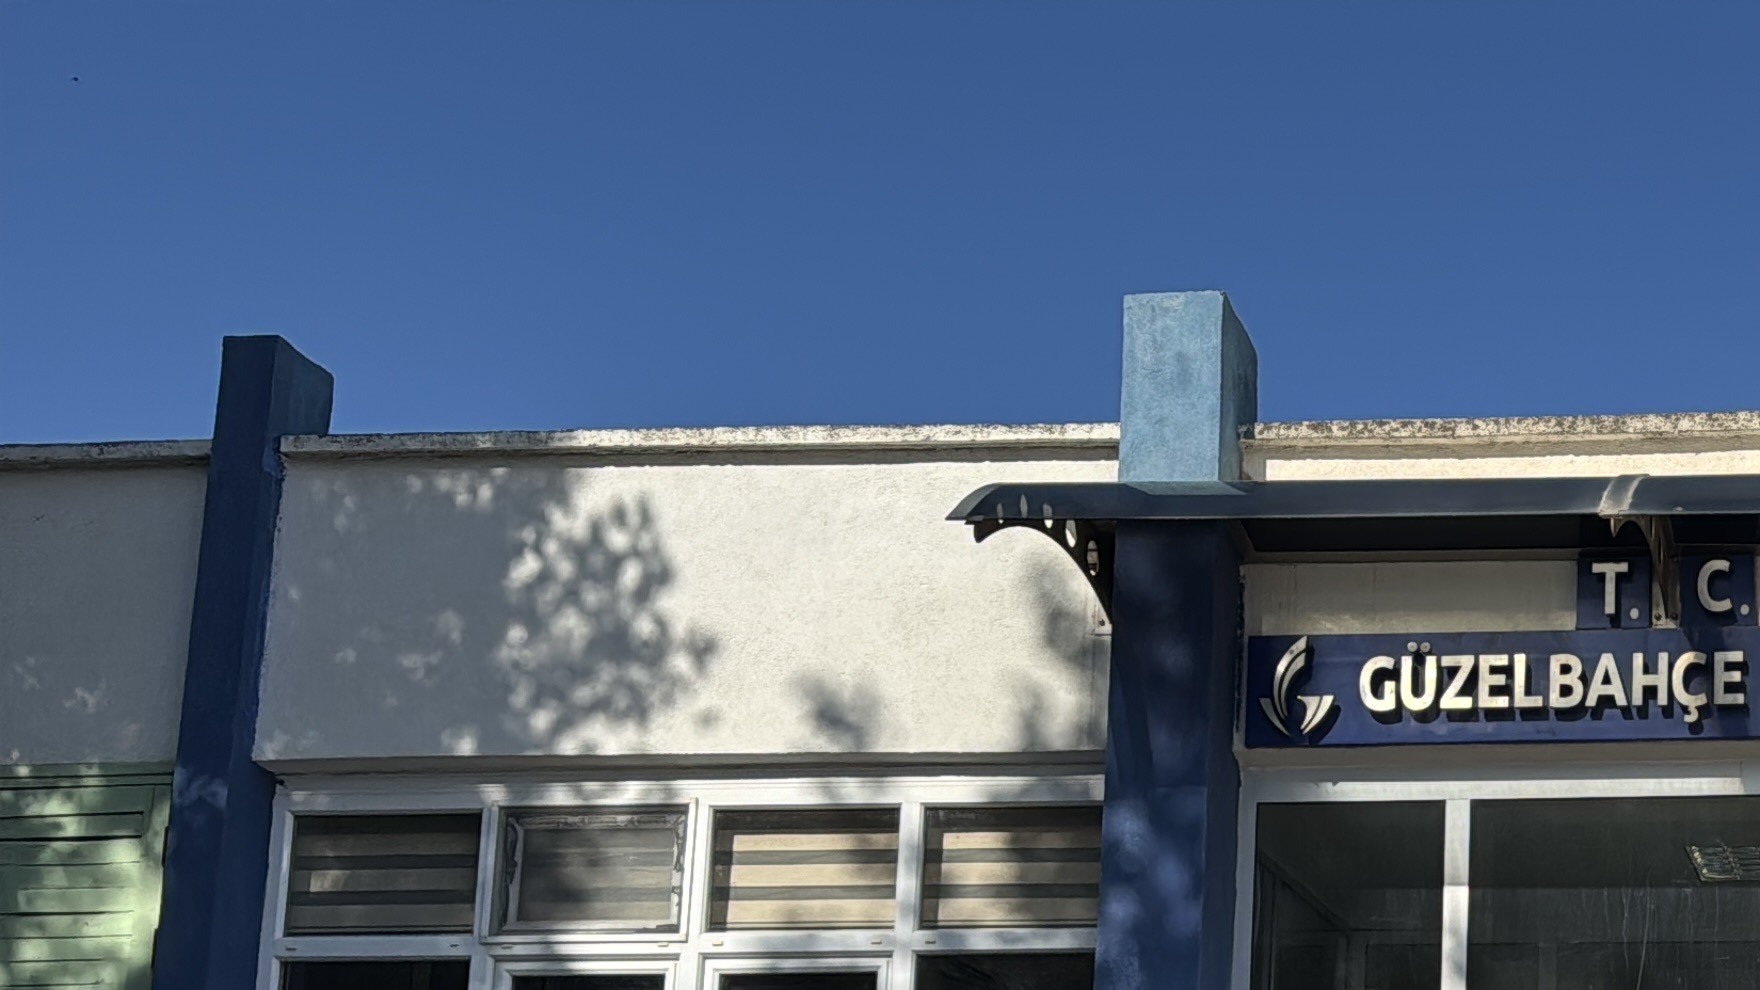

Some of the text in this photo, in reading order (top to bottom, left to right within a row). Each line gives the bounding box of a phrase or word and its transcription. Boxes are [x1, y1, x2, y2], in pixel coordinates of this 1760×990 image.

[1591, 559, 1750, 620] T. C.
[1358, 641, 1746, 723] GÜZELBAHÇE
